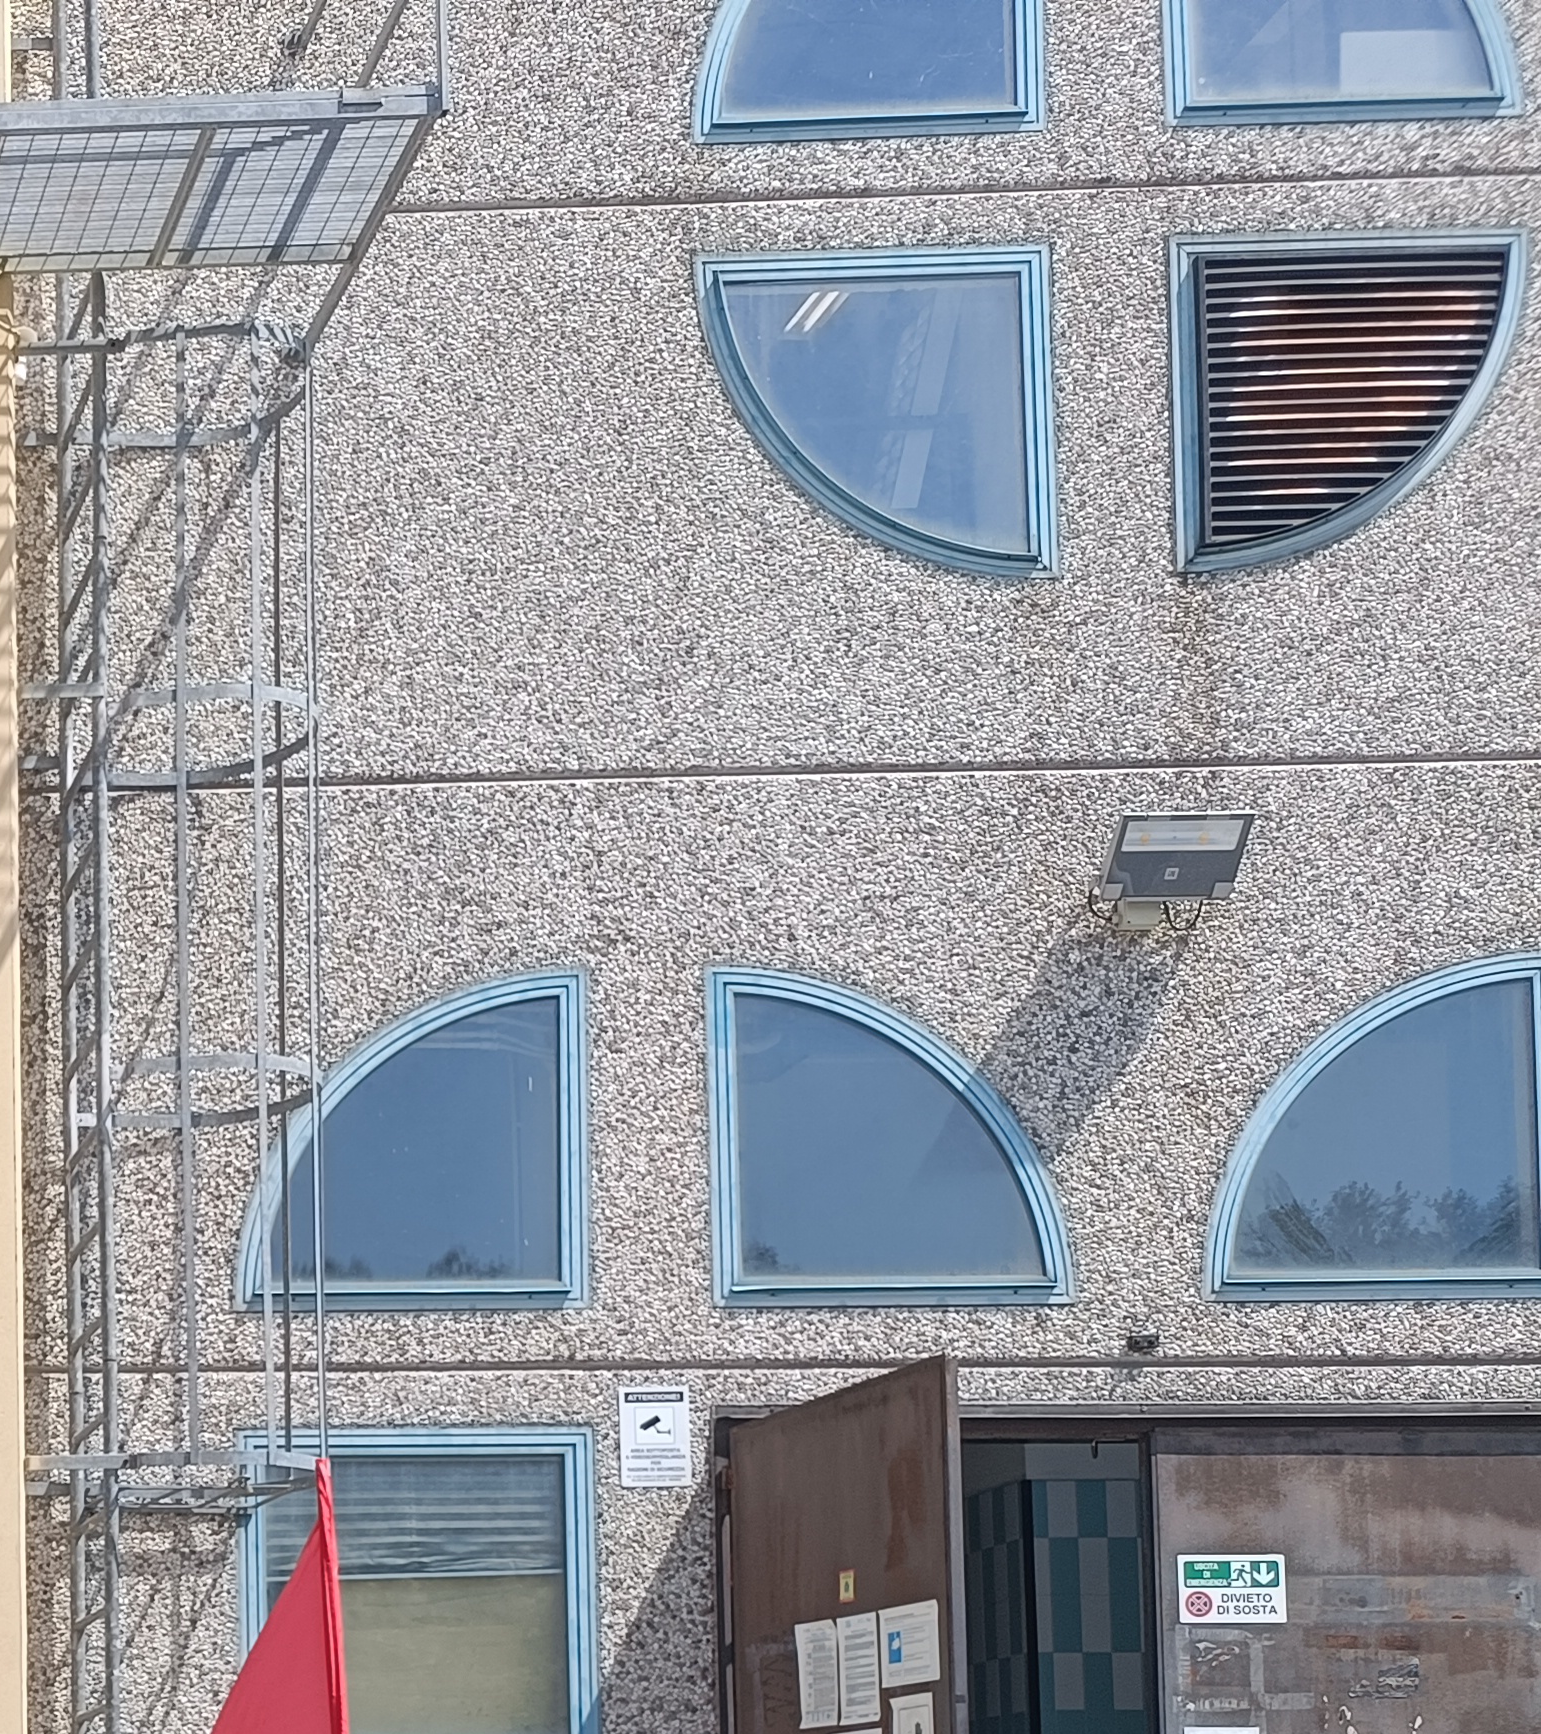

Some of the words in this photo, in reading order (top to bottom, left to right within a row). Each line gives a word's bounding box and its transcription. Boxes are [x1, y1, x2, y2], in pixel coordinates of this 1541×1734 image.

[1221, 1593, 1273, 1604] DIVIETO
[1216, 1605, 1230, 1615] DI
[1233, 1604, 1278, 1615] SOSTA
